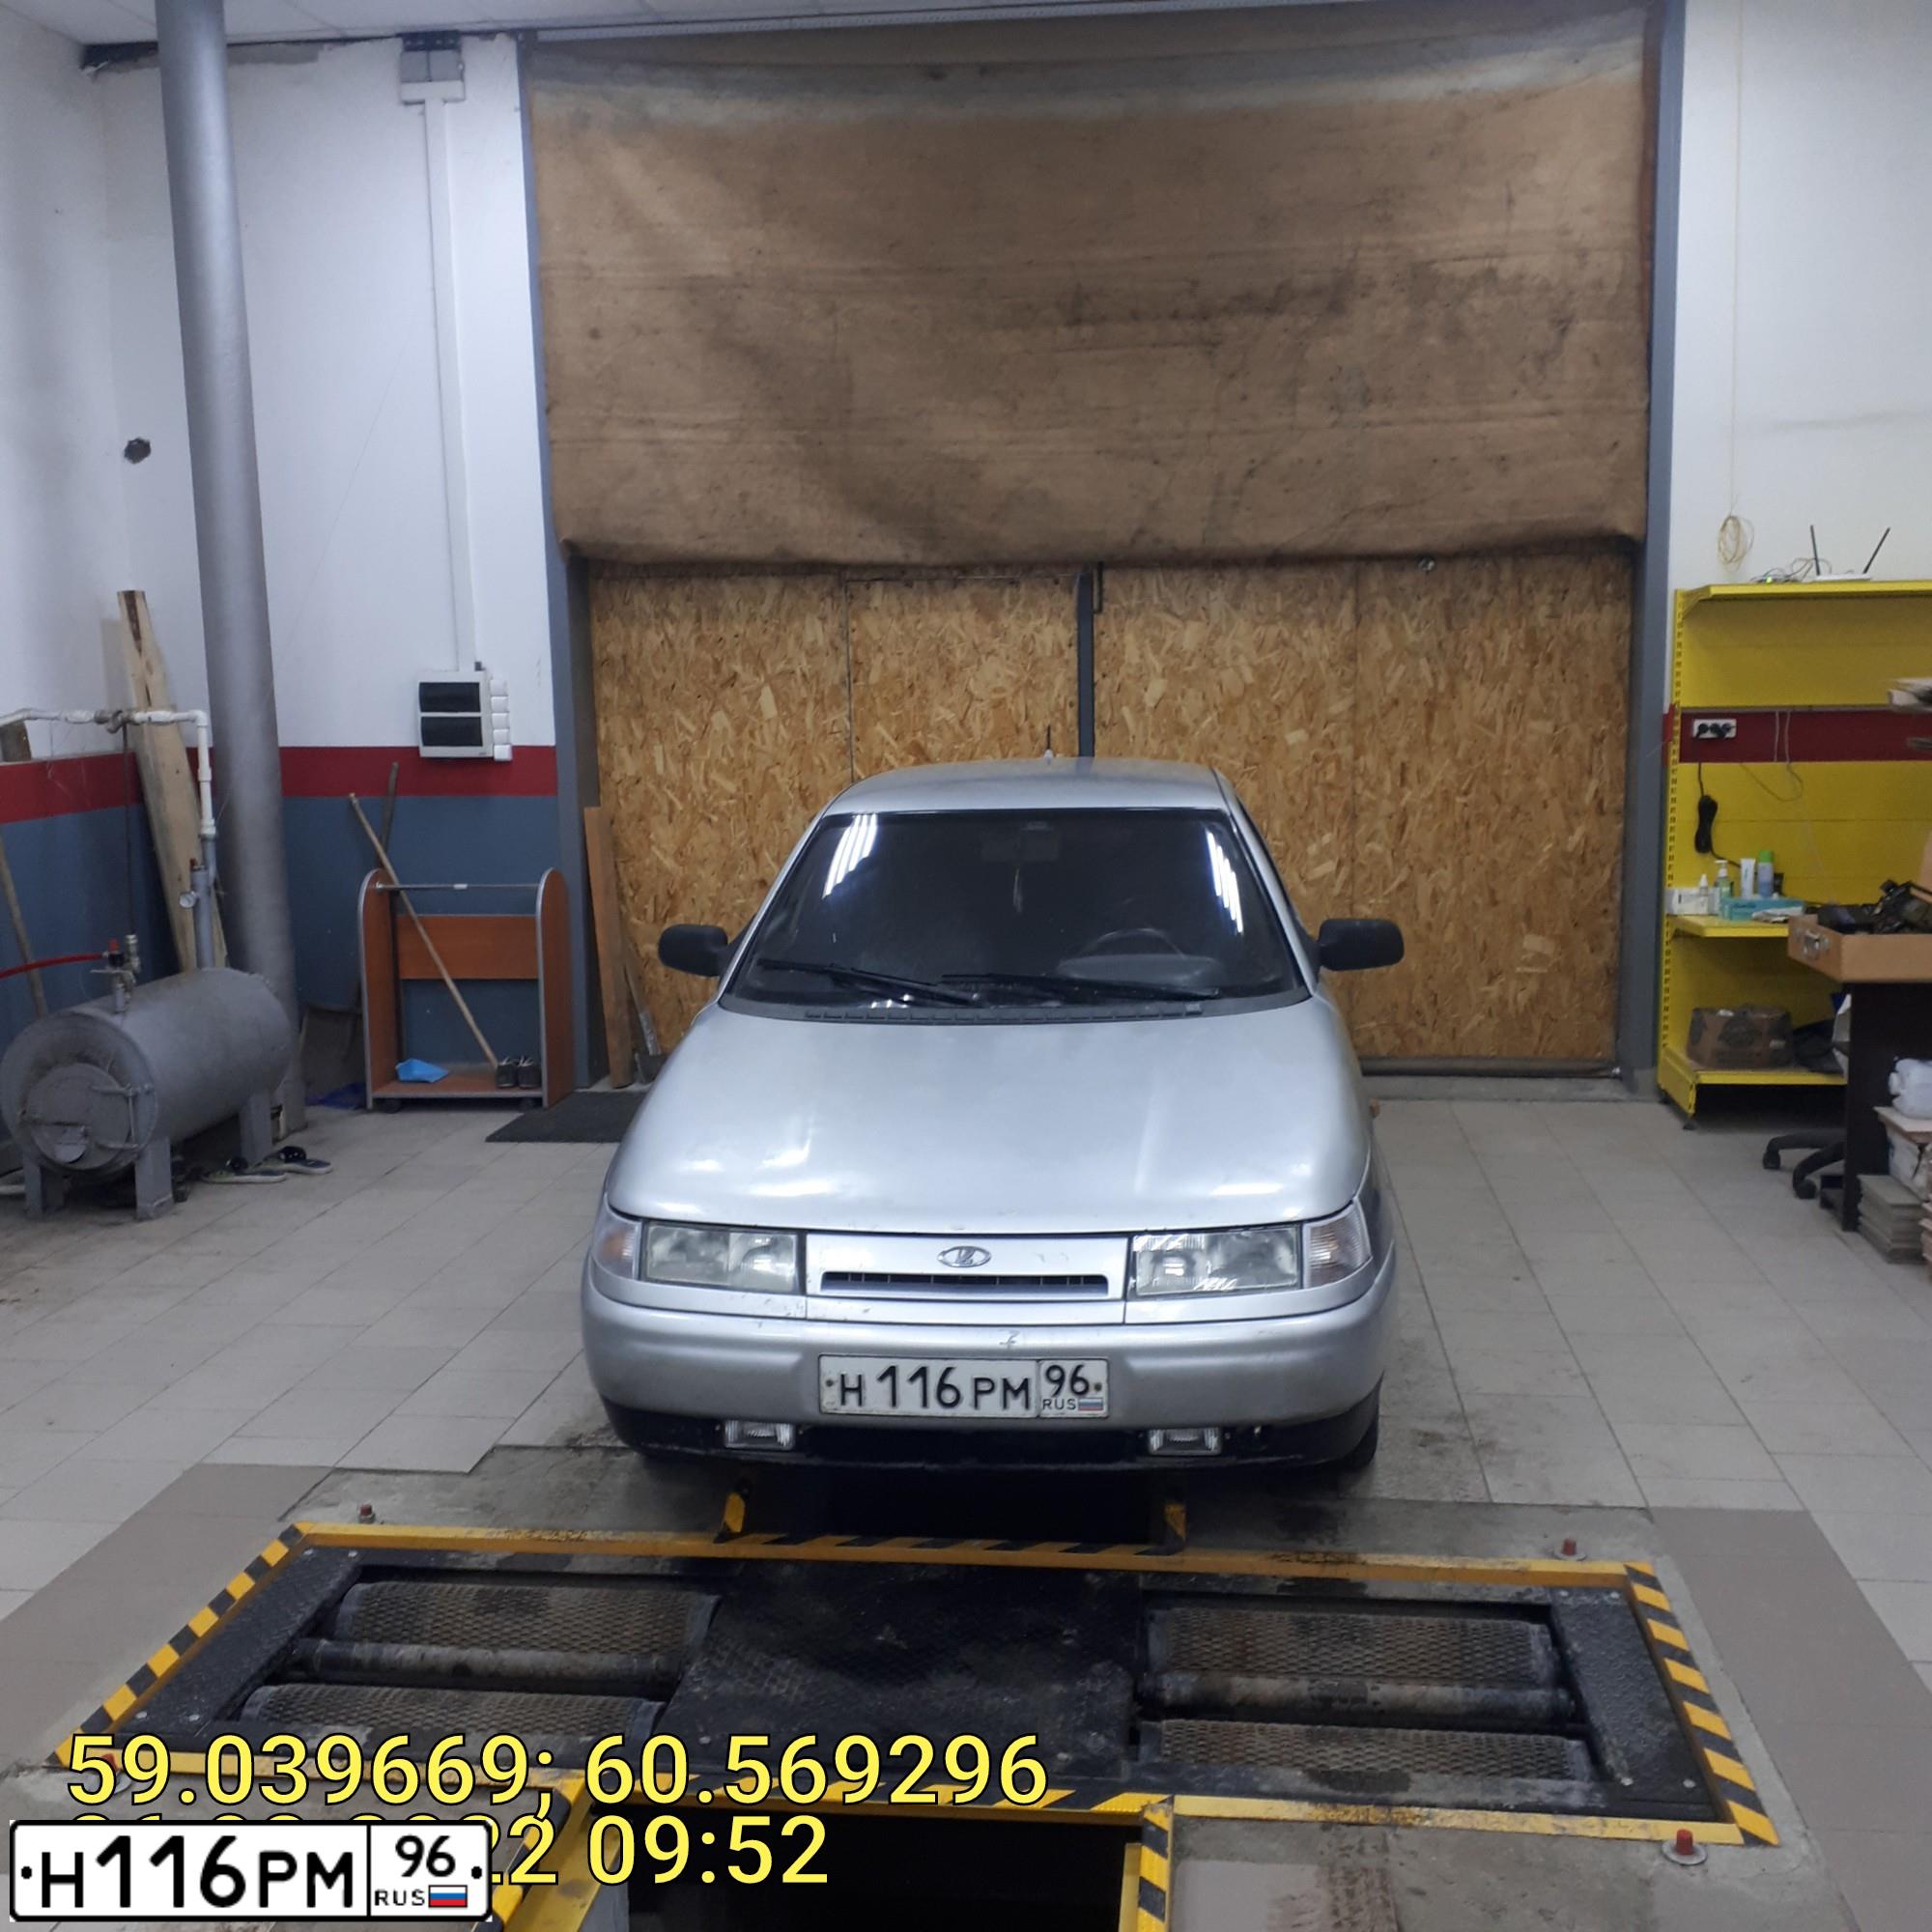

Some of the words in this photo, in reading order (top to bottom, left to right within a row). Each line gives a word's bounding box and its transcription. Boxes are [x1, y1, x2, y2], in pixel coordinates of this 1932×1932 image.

[839, 1364, 1031, 1410] Н116РМ
[1044, 1364, 1090, 1397] 96
[1042, 1398, 1076, 1410] RUS
